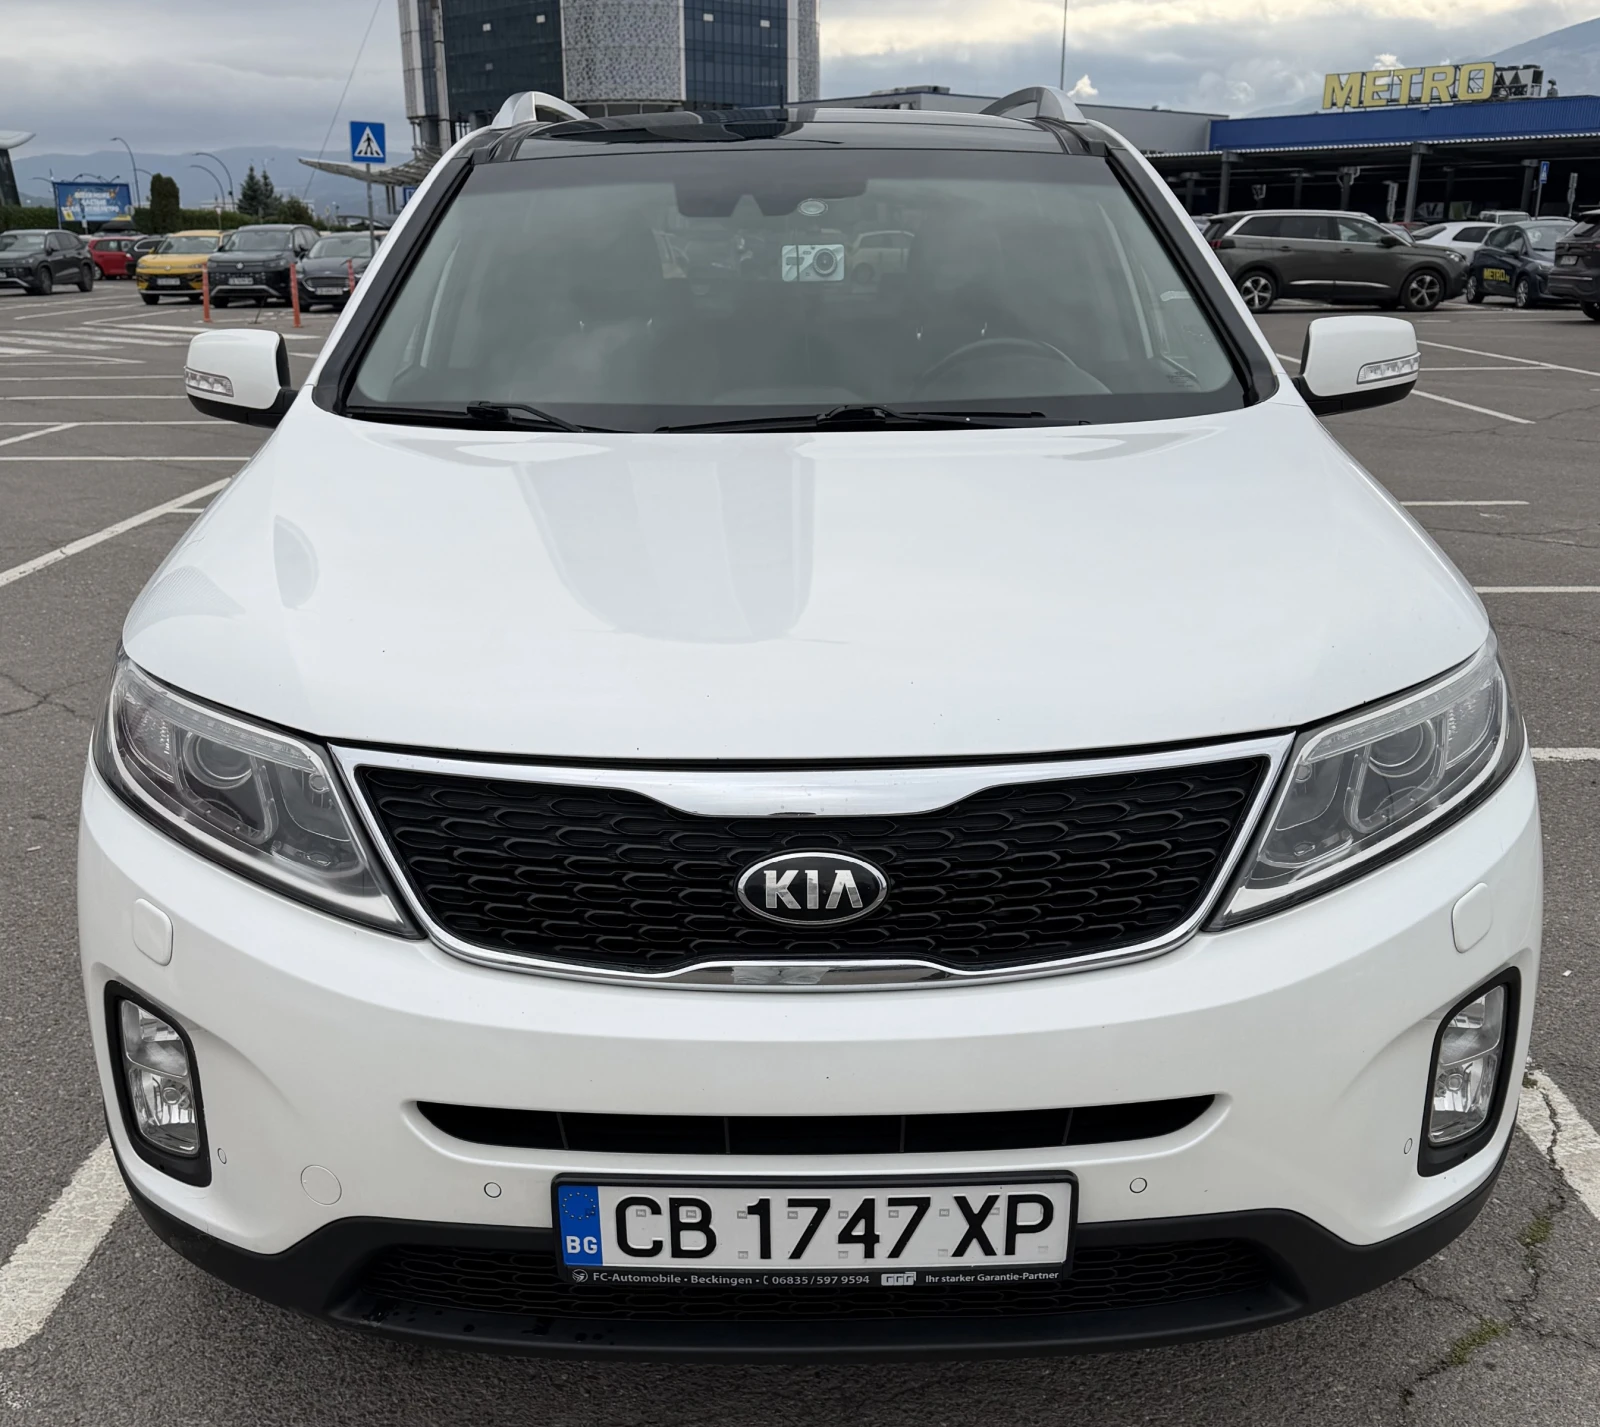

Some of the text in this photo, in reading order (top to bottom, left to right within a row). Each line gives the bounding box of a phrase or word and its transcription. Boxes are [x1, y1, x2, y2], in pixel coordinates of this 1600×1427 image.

[1322, 61, 1496, 110] METRO
[763, 869, 864, 910] KIA
[615, 1193, 1055, 1260] CB 1747 XP
[566, 1235, 598, 1254] BG
[593, 1272, 682, 1284] FC-Automobile
[690, 1274, 753, 1287] Beckingen
[840, 1275, 871, 1285] 9594
[925, 1271, 1060, 1283] Ihr starker Garantie-Partner
